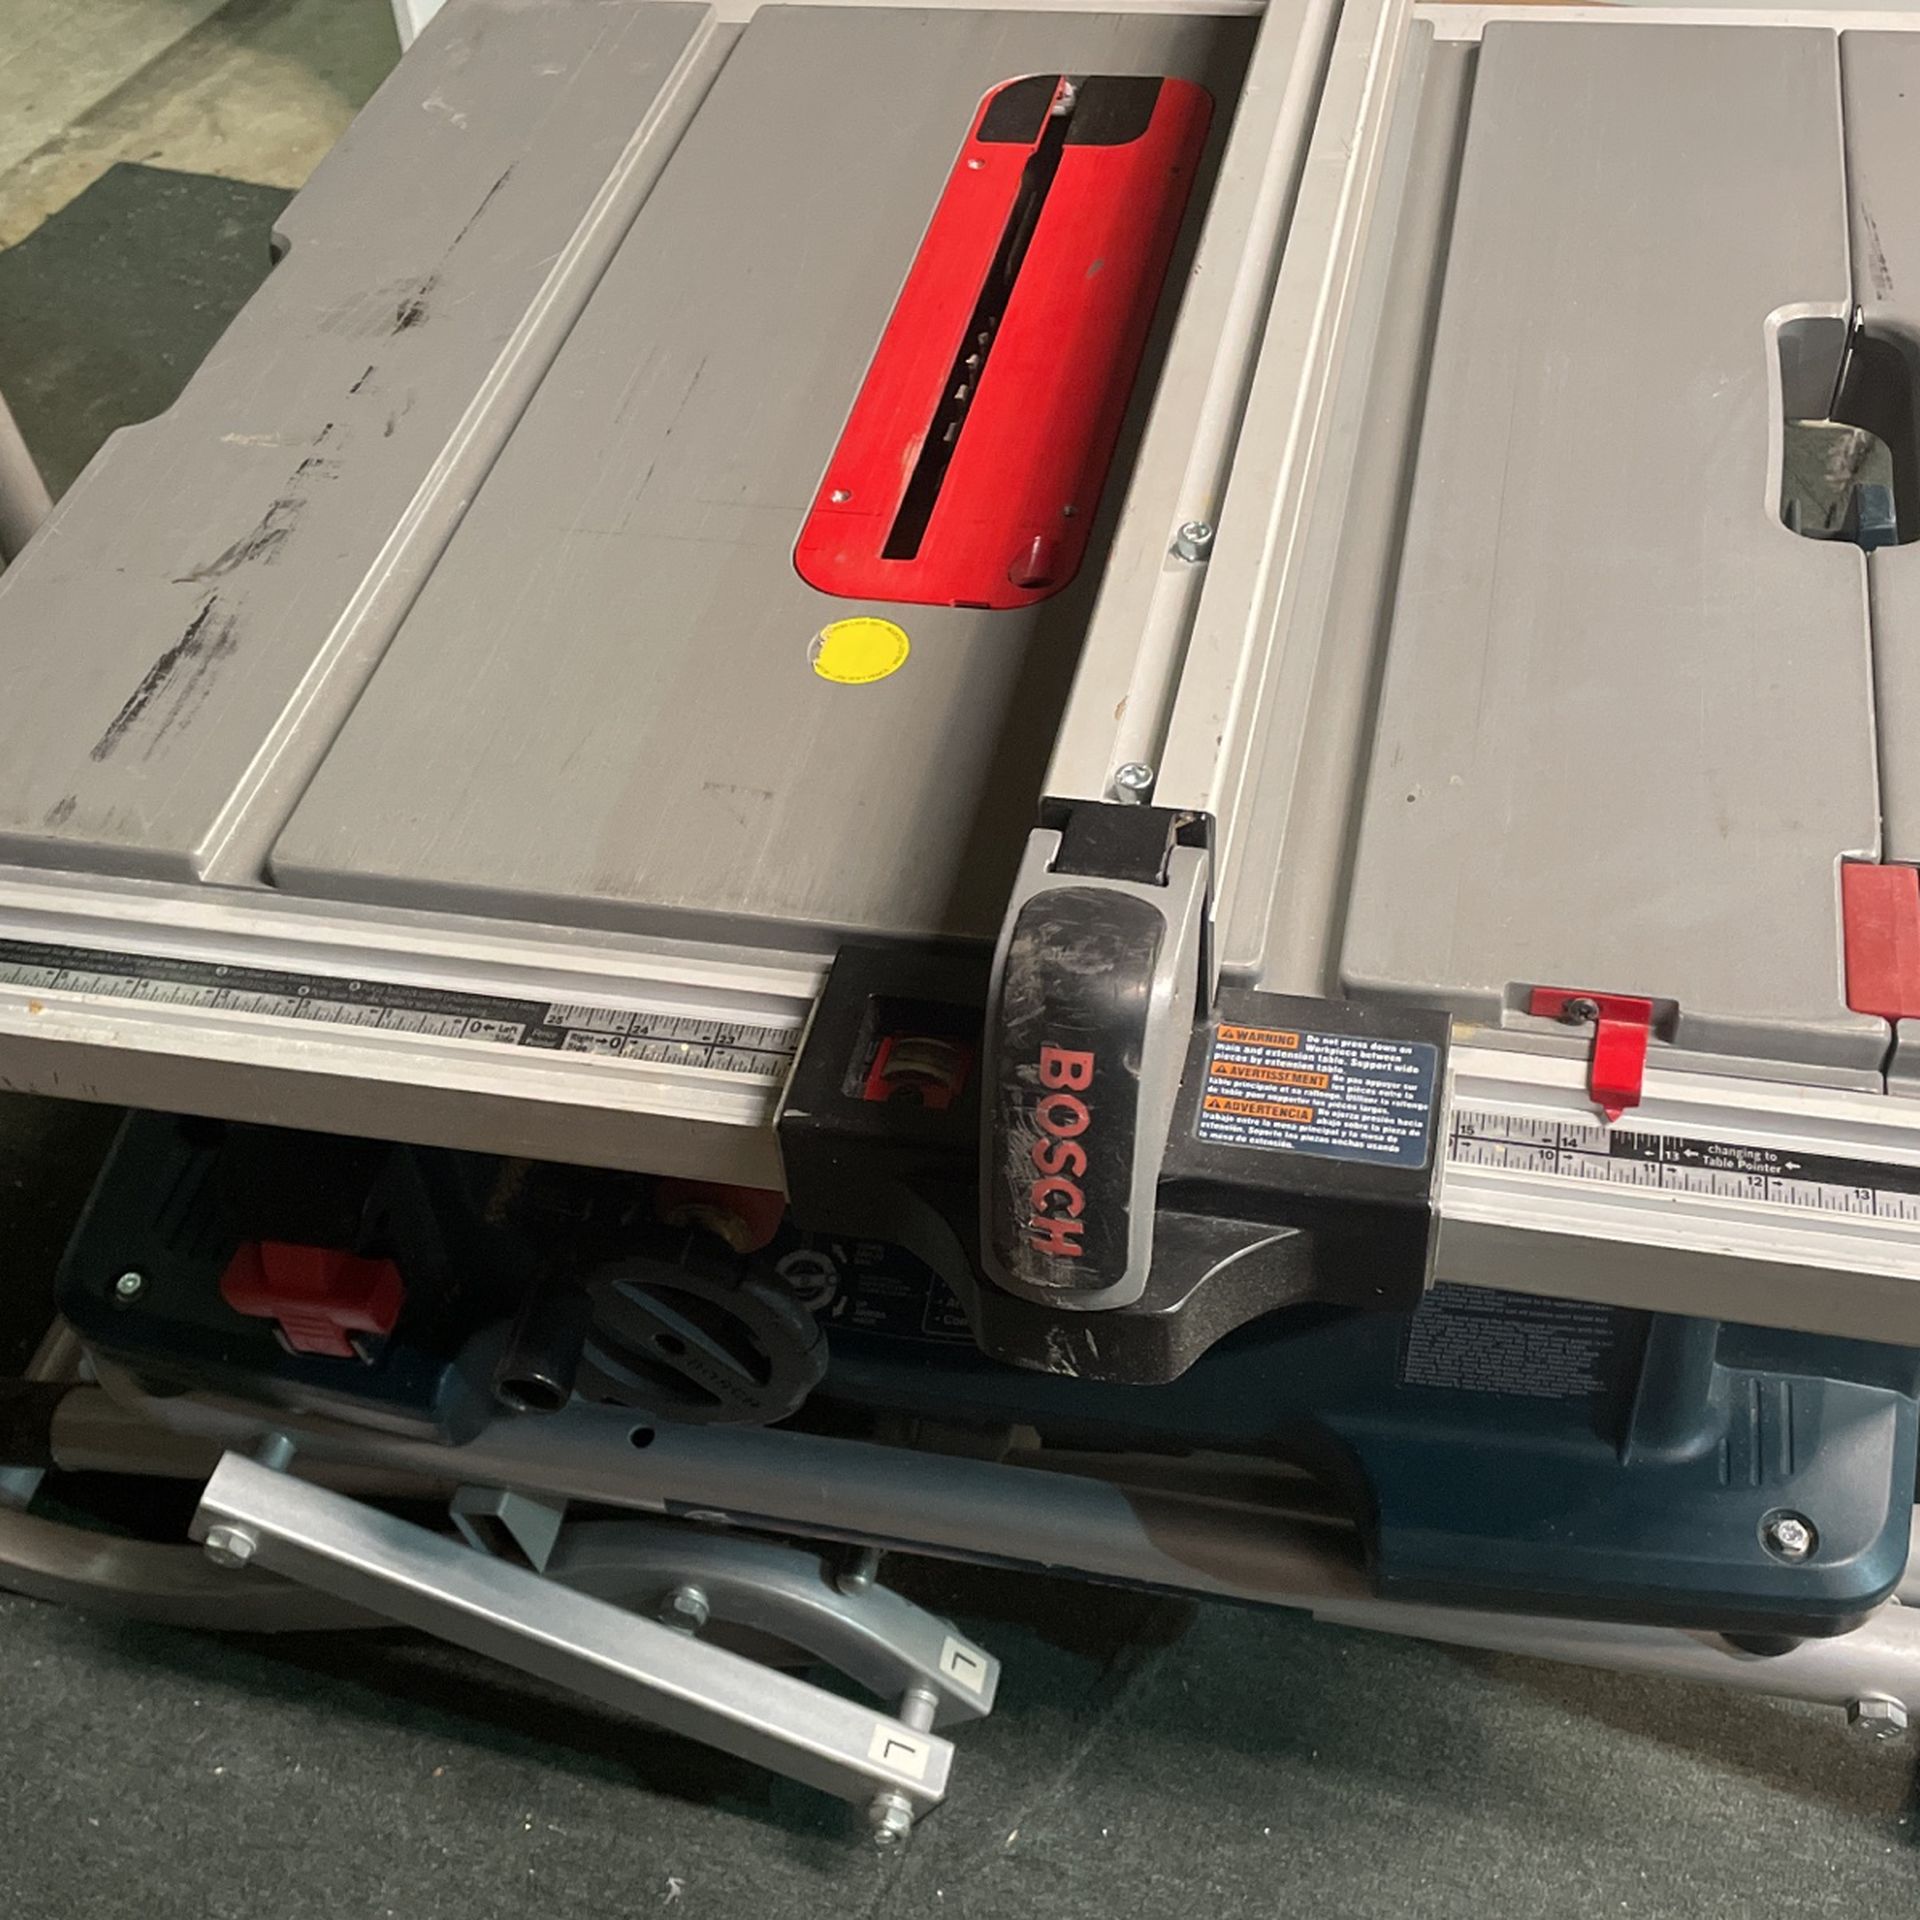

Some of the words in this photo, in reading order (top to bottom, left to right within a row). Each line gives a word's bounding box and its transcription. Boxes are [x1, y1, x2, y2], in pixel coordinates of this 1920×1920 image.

[546, 1015, 564, 1025] 25
[632, 1025, 649, 1035] 24
[719, 1035, 735, 1044] 23
[1236, 1030, 1295, 1046] WARNING
[1307, 1035, 1320, 1044] Do
[1323, 1038, 1339, 1046] not
[1341, 1040, 1368, 1049] press
[1370, 1042, 1397, 1052] down
[1215, 1043, 1241, 1052] main
[1243, 1046, 1263, 1055] and
[1265, 1049, 1315, 1061] extension
[1350, 1058, 1392, 1071] Support
[1394, 1064, 1420, 1074] wide
[1305, 1044, 1358, 1057] Workpiece
[1360, 1050, 1402, 1062] between
[1213, 1052, 1247, 1062] pieces
[1250, 1056, 1263, 1065] by
[1264, 1059, 1315, 1070] extension
[1230, 1066, 1325, 1086] AVERTISSEMENT
[1346, 1077, 1363, 1085] pas
[1364, 1079, 1402, 1090] appuyer
[1403, 1083, 1418, 1091] sur
[1207, 1085, 1218, 1094] de
[1221, 1087, 1243, 1097] table
[1245, 1090, 1266, 1099] pour
[1208, 1077, 1232, 1086] table
[1233, 1080, 1278, 1092] principale
[1279, 1085, 1289, 1093] et
[1291, 1087, 1302, 1095] sa
[1404, 1091, 1414, 1100] la
[1224, 1101, 1309, 1119] ADVERTENCIA
[1397, 1118, 1424, 1128] hacia
[1236, 1117, 1260, 1125] entre
[1273, 1121, 1297, 1130] mesa
[1299, 1124, 1340, 1136] principal
[1360, 1132, 1385, 1141] mesa
[1316, 1117, 1341, 1128] abajo
[1344, 1120, 1368, 1130] sobre
[1382, 1126, 1407, 1136] pieza
[1408, 1129, 1421, 1137] de
[1460, 1125, 1475, 1136] 15
[1209, 1133, 1234, 1141] mesa
[1561, 1137, 1578, 1148] 14
[1030, 1046, 1095, 1257] BOSCH
[1538, 1150, 1554, 1160] 10
[1665, 1150, 1680, 1161] 13
[1707, 1144, 1761, 1162] changing
[1764, 1152, 1778, 1162] to
[1643, 1164, 1656, 1173] 11
[1703, 1156, 1734, 1168] Table
[1738, 1160, 1782, 1174] Pointer
[1747, 1176, 1763, 1187] 12
[1855, 1189, 1870, 1200] 13
